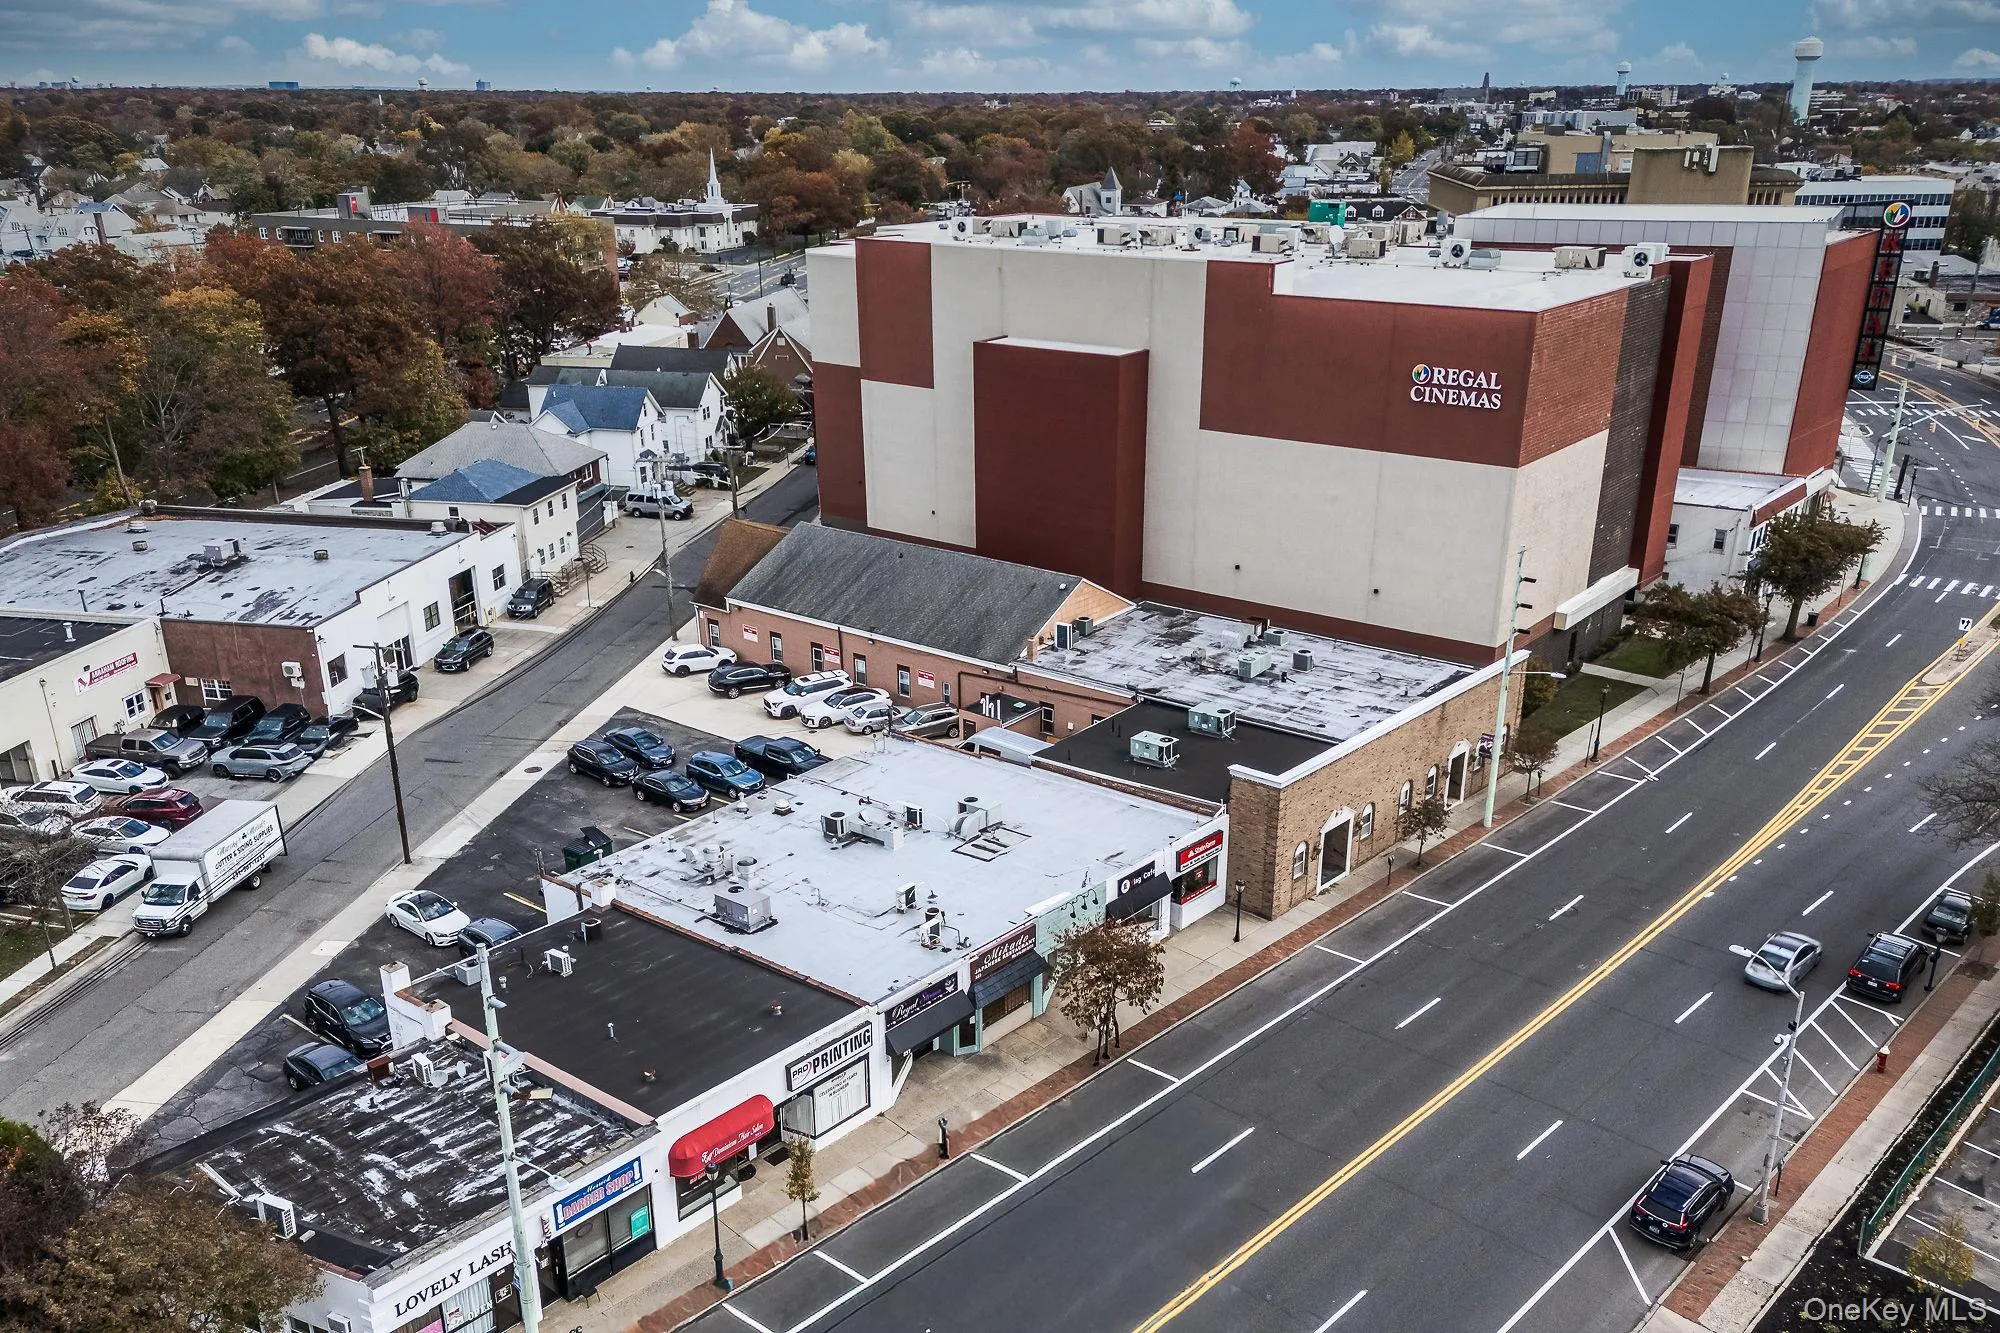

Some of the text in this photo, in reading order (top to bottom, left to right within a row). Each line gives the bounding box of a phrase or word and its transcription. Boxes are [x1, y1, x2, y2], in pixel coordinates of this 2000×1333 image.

[1431, 366, 1502, 390] REGAL
[1410, 385, 1502, 410] CINEMAS
[215, 852, 233, 870] GUTTER
[237, 838, 253, 854] SIDING
[253, 824, 274, 843] SUPPLIES
[974, 957, 1002, 975] JAPANESE
[1002, 937, 1035, 960] RESTAURANT
[984, 934, 1029, 965] Mikado
[891, 998, 919, 1019] Royal
[792, 1028, 871, 1079] PRO PRINTING
[562, 1186, 605, 1220] BARBER
[605, 1170, 634, 1196] SHOP
[394, 1268, 462, 1318] LOVELY
[468, 1240, 512, 1277] LASH
[467, 1302, 493, 1320] OPEN
